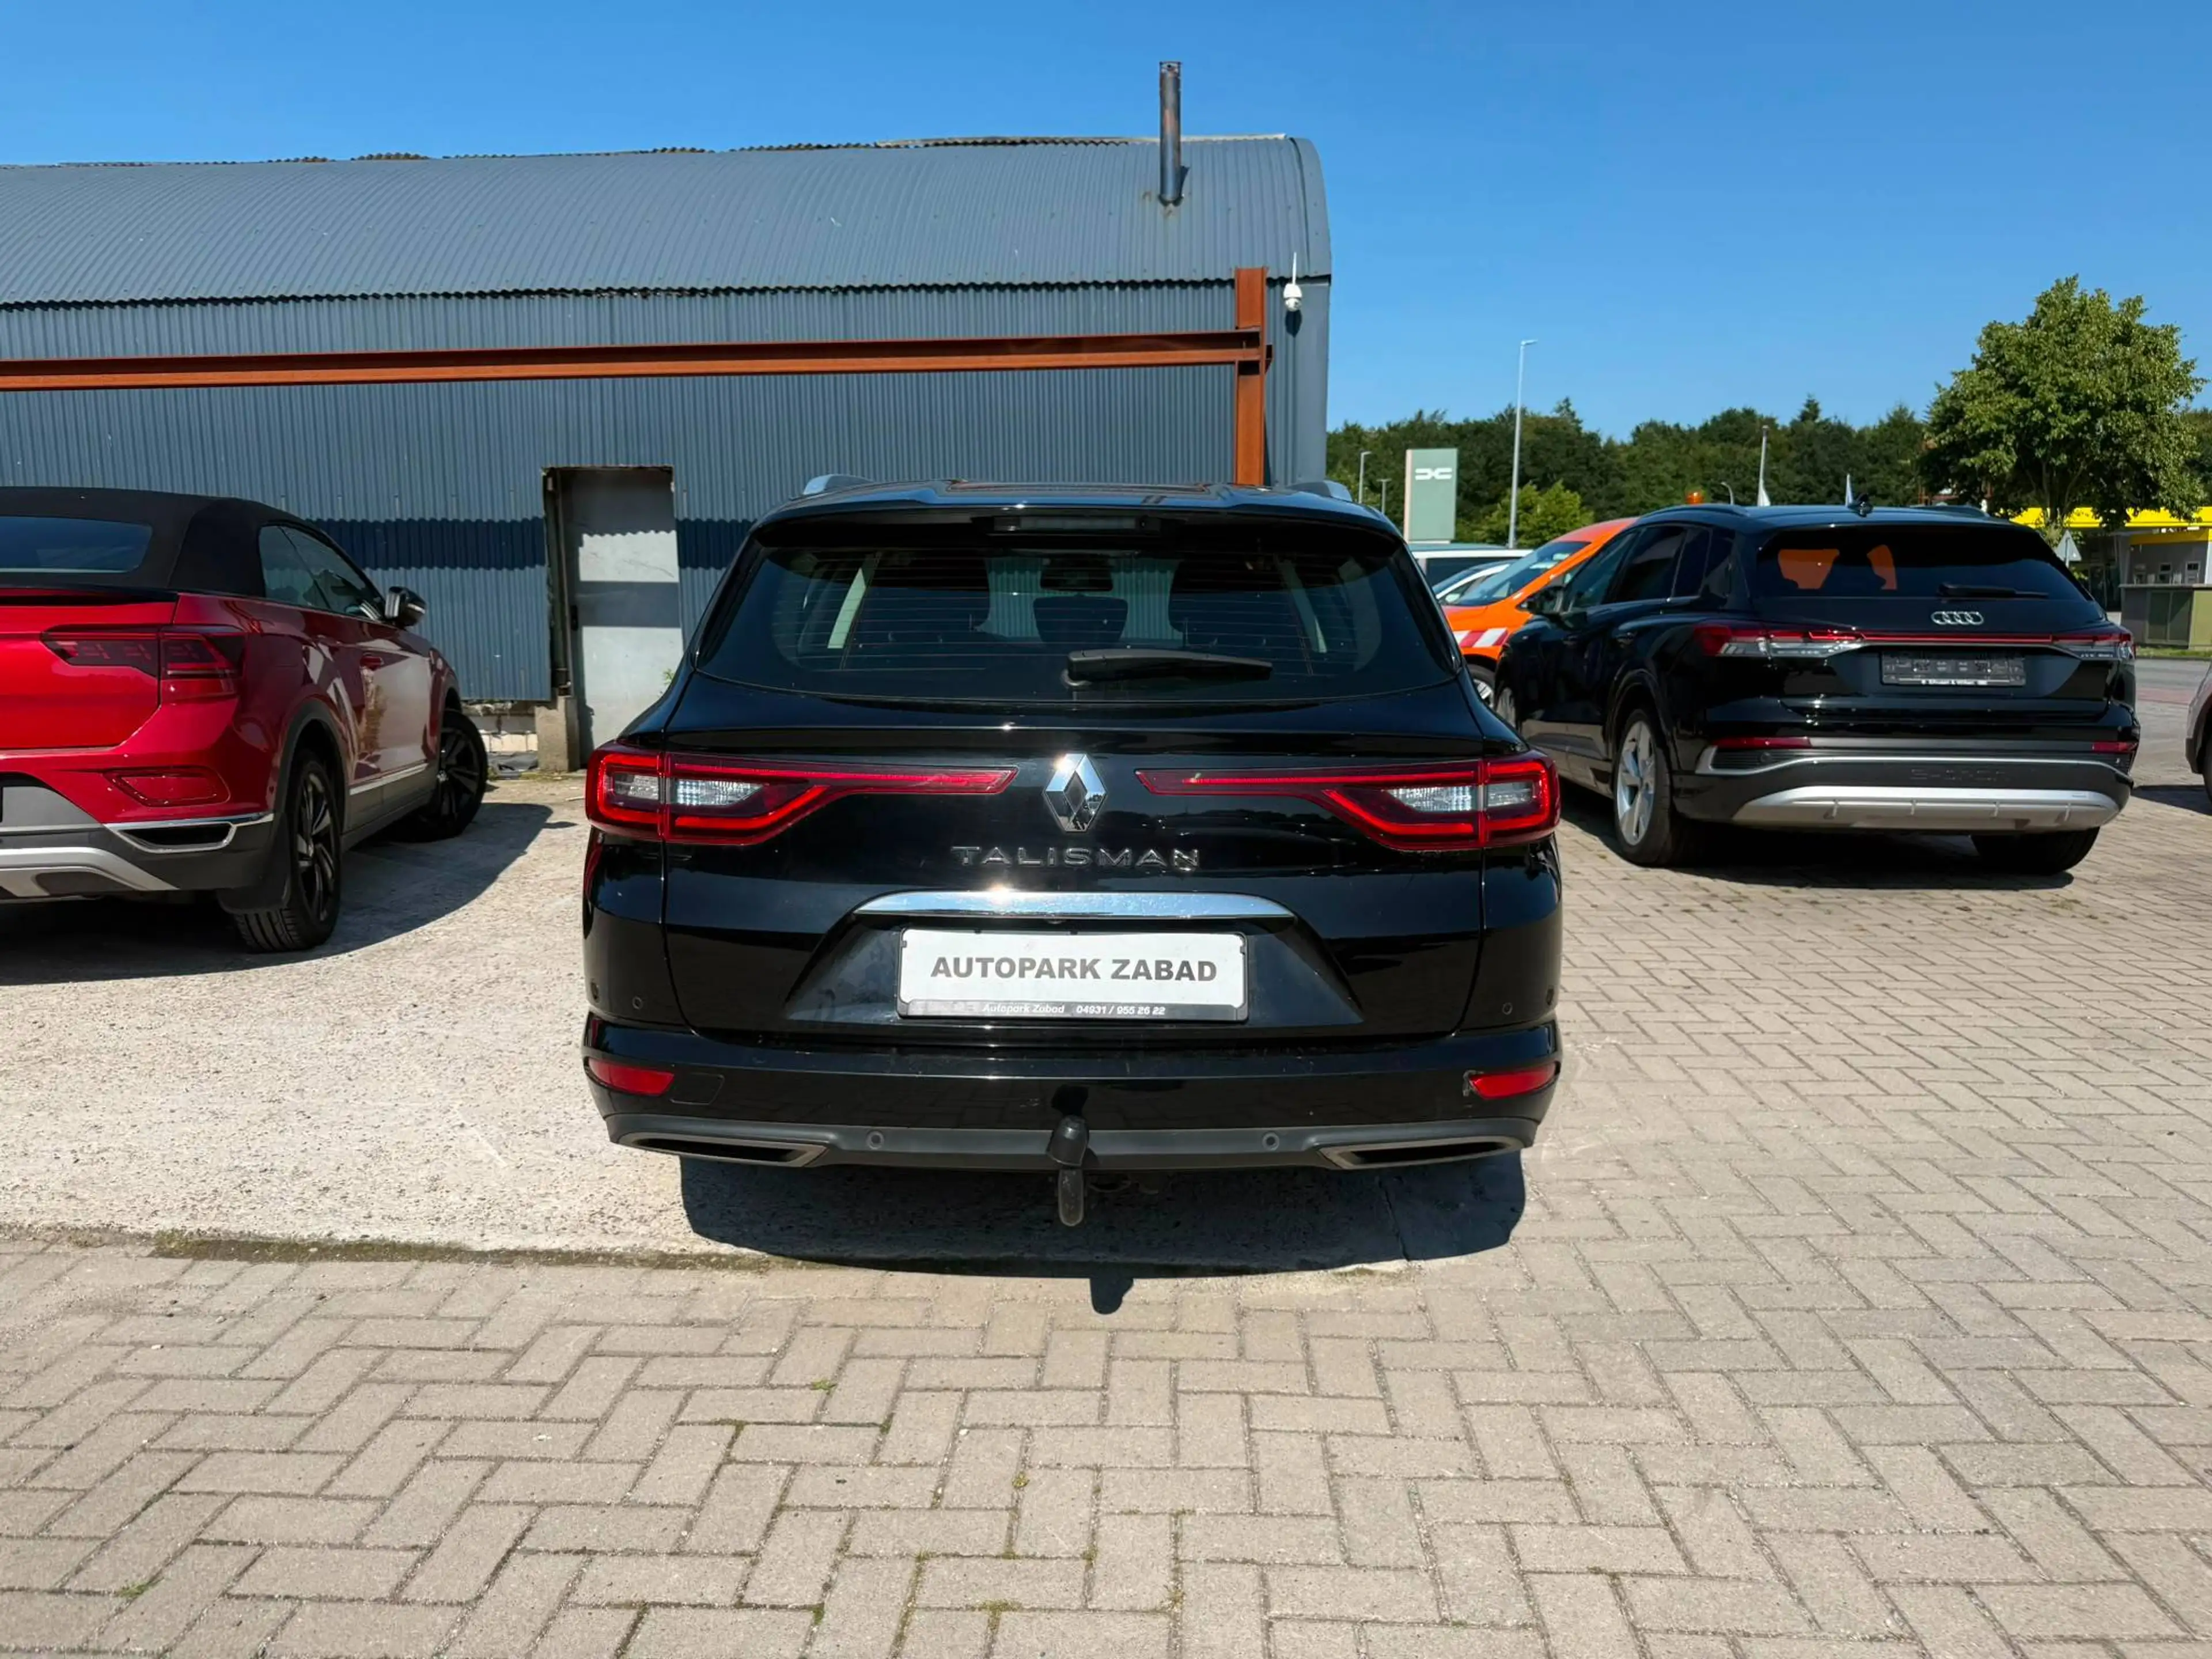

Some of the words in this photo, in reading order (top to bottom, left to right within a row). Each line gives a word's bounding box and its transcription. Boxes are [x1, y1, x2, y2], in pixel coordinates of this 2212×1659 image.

[950, 846, 1199, 870] TALISMAN
[930, 957, 1101, 980] AUTOPARK
[1111, 959, 1218, 982] ZABAD
[982, 1003, 1029, 1014] Autopark
[1032, 1003, 1065, 1013] Zabad
[1076, 1005, 1106, 1014] 04931
[1152, 1006, 1165, 1015] 22
